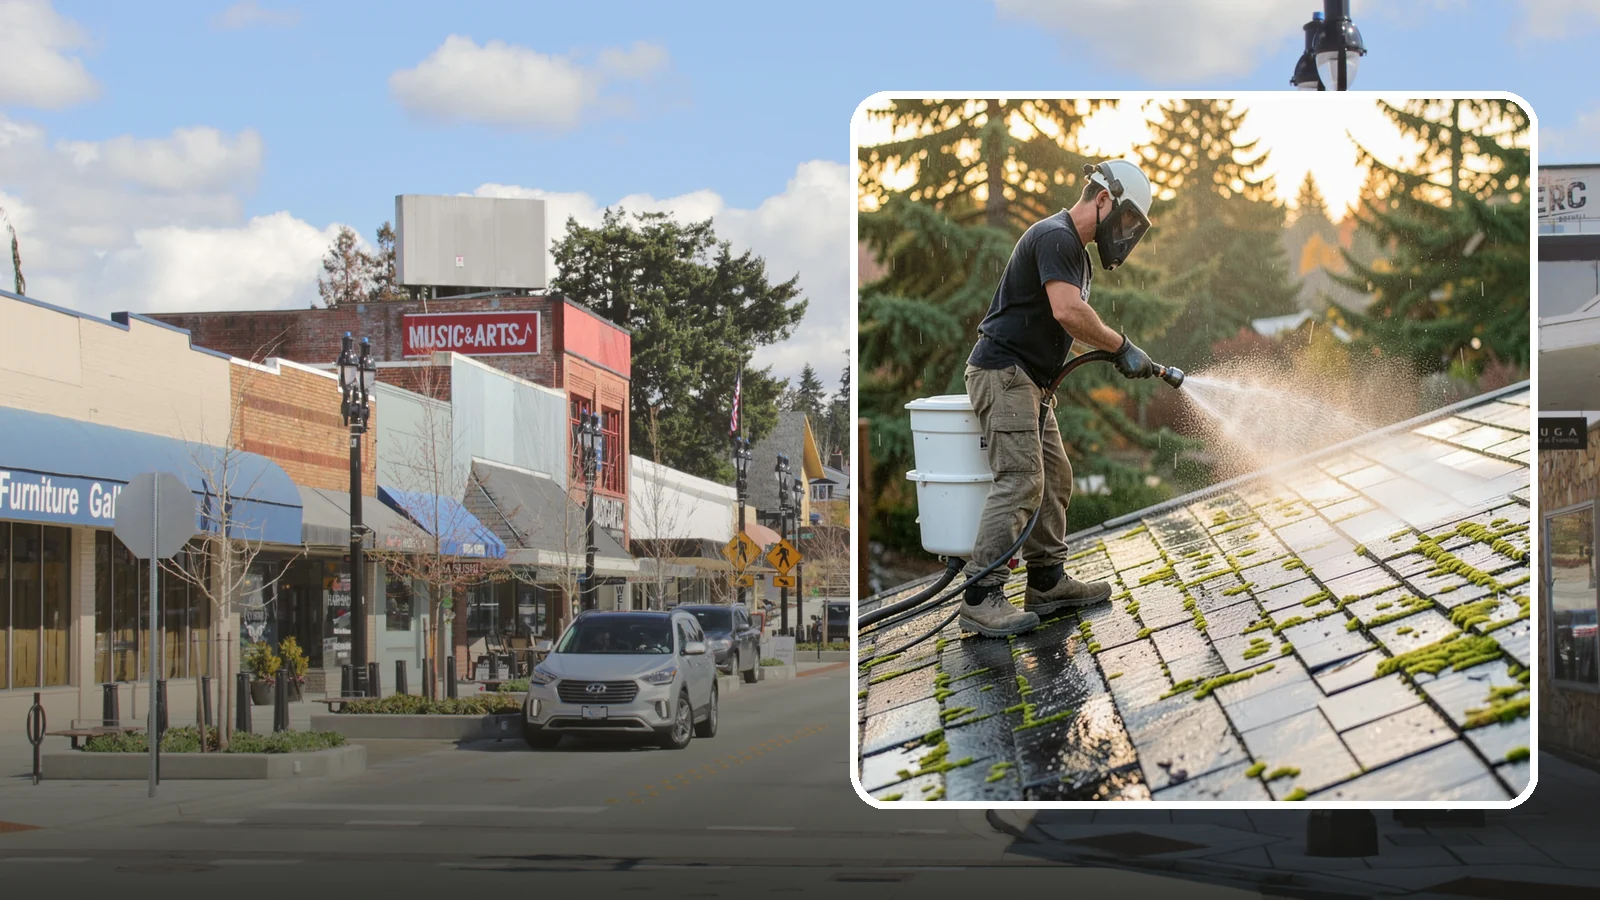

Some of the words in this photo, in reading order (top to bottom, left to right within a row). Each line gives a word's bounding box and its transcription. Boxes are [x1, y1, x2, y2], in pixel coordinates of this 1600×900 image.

[409, 323, 520, 349] MUSIC&ARTS
[1540, 427, 1577, 436] UGA
[0, 471, 79, 515] Furniture
